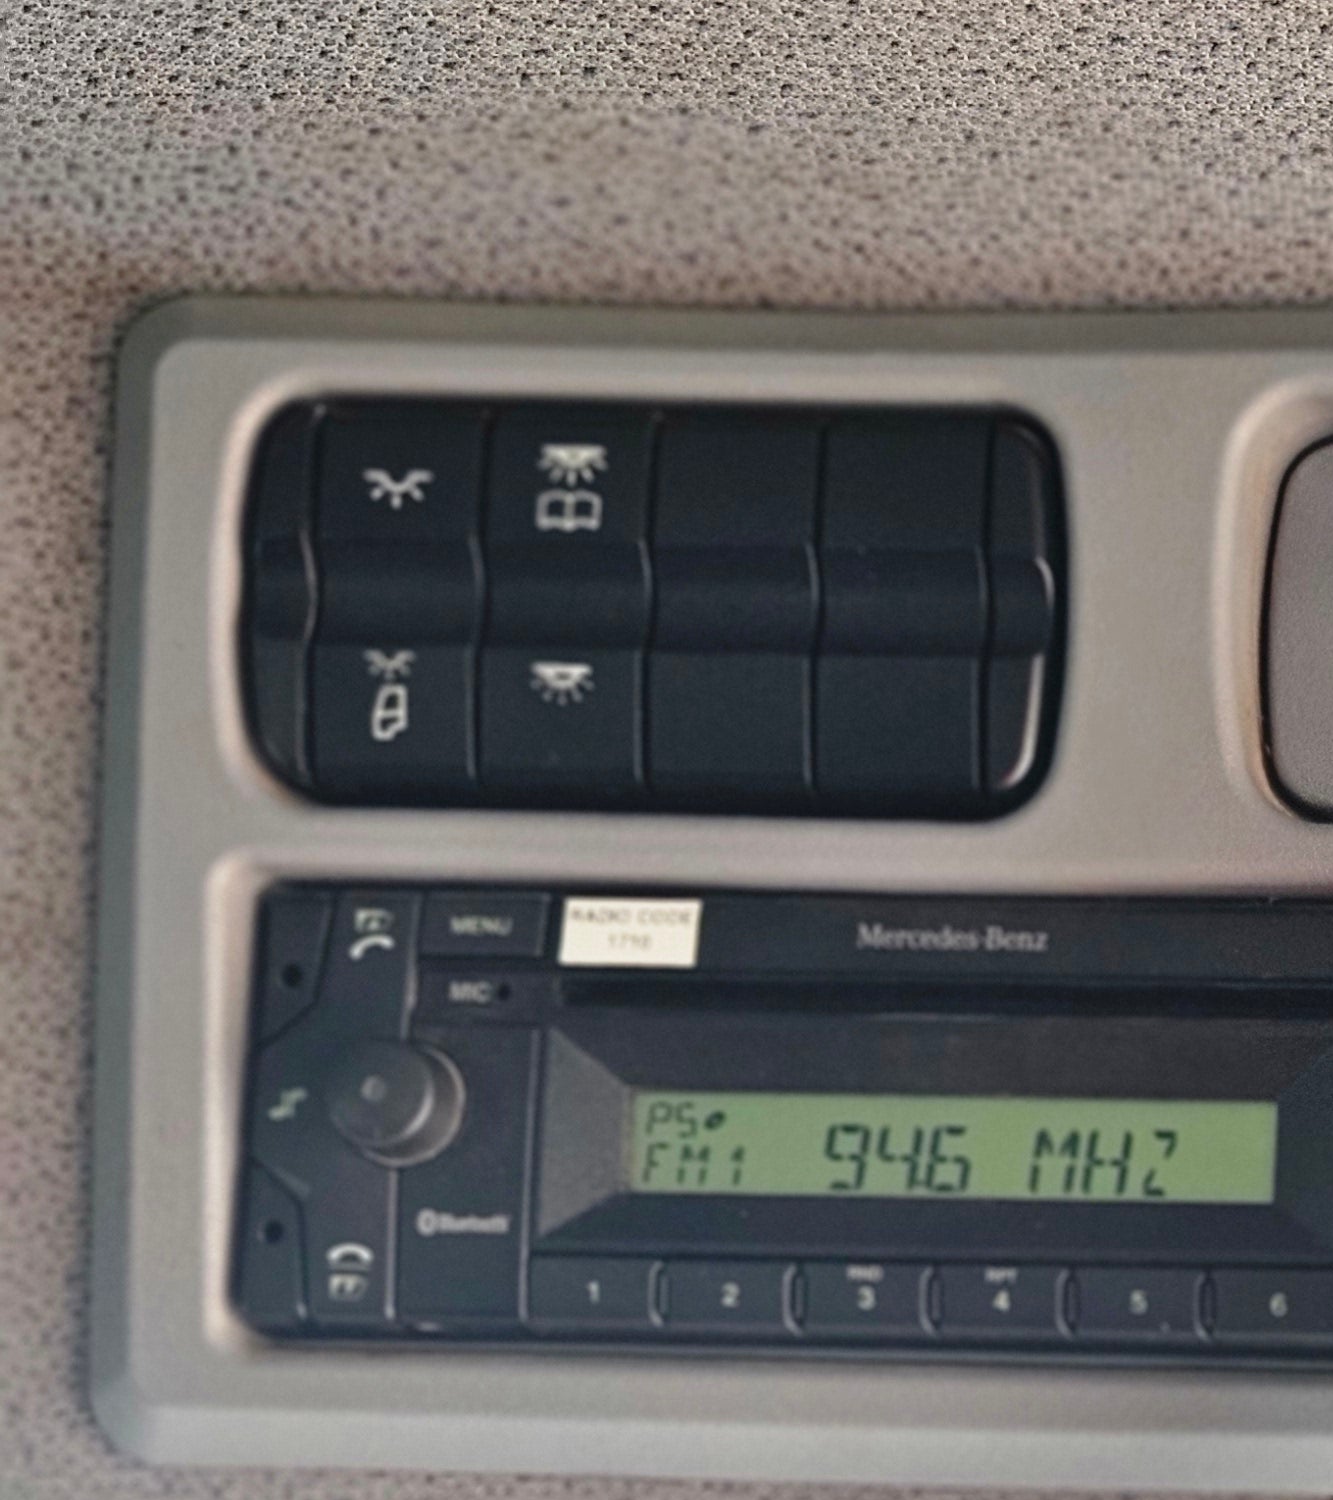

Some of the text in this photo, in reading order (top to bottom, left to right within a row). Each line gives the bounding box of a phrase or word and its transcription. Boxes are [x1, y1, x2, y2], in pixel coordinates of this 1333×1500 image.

[450, 916, 513, 937] MENU
[449, 980, 492, 1003] MIC
[642, 1141, 745, 1185] FM1
[586, 1279, 600, 1304] 1
[720, 1281, 742, 1308] 2
[856, 1284, 877, 1311] 3
[991, 1289, 1011, 1312] 4
[1128, 1288, 1149, 1316] 5
[1268, 1291, 1289, 1318] 6
